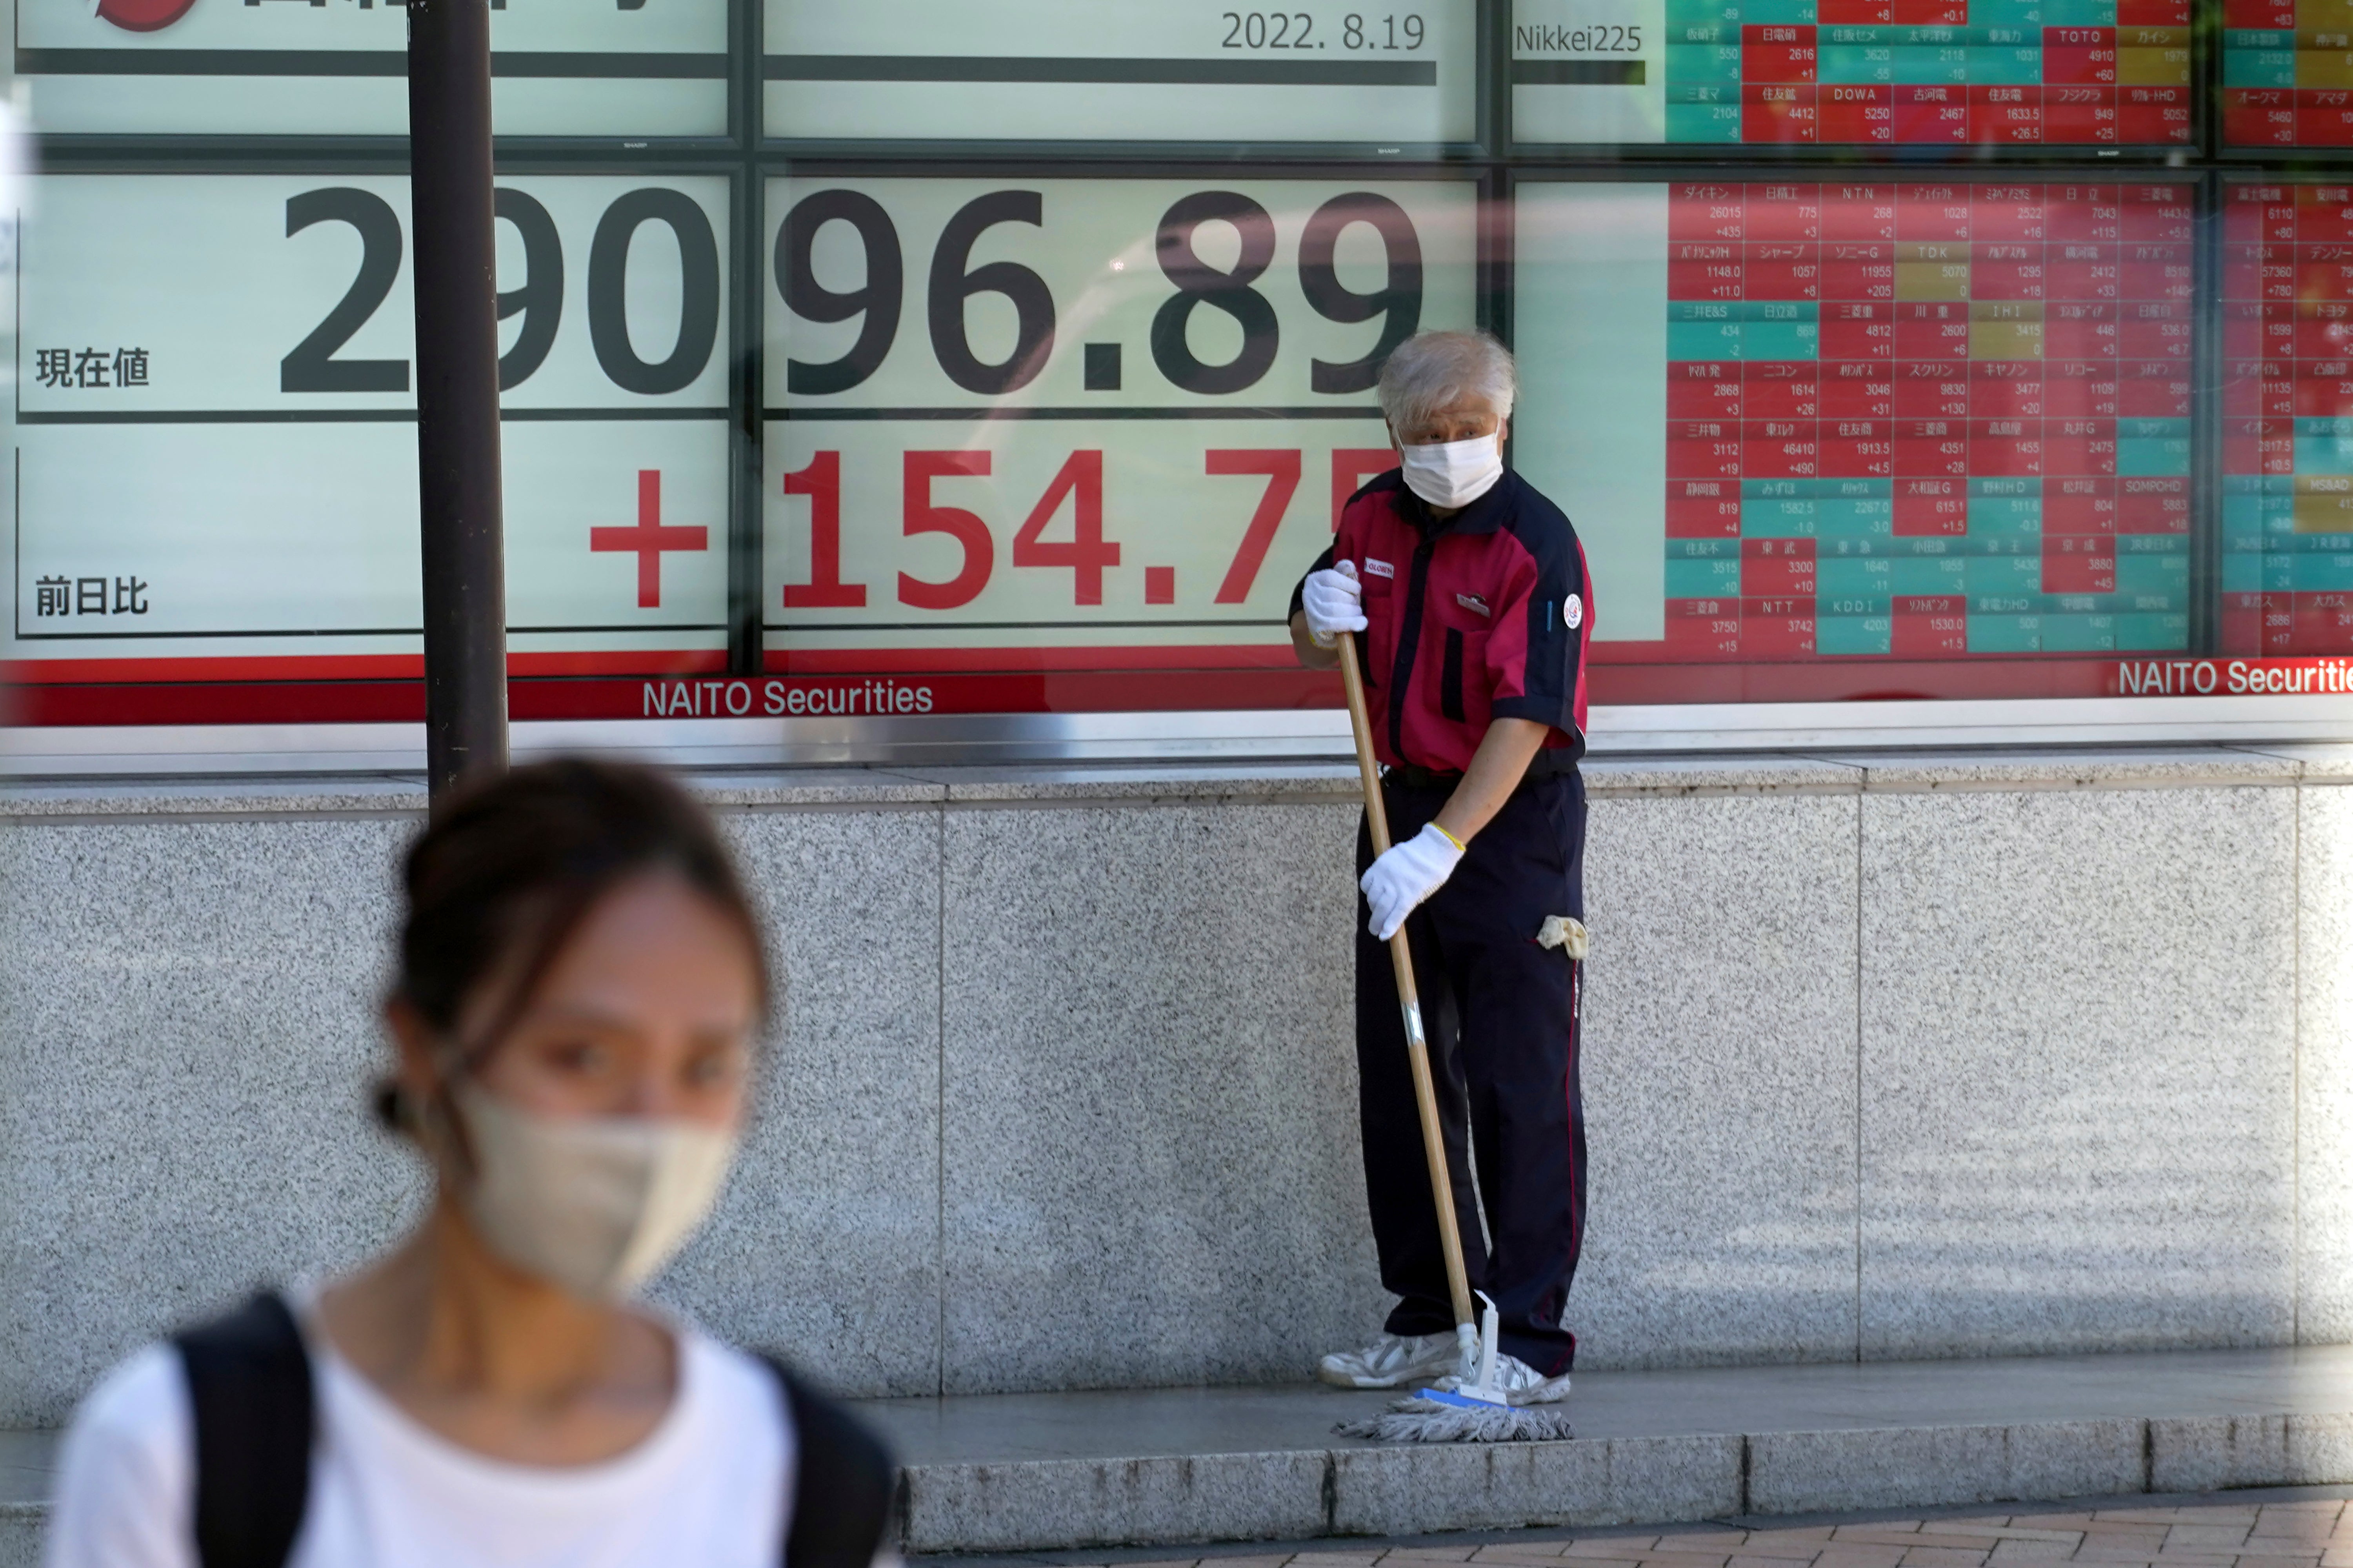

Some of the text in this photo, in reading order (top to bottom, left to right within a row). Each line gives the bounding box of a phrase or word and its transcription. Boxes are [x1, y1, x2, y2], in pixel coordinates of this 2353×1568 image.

[1877, 9, 1889, 20] +8
[1943, 10, 1963, 21] +0.1
[1343, 13, 1425, 50] 8.19
[2059, 30, 2100, 43] TOTO
[1517, 25, 1642, 52] Nikkei225
[1789, 48, 1814, 60] 2616
[2089, 50, 2113, 62] 4910
[1801, 68, 1813, 79] +1
[2095, 69, 2113, 80] +60
[1834, 88, 1876, 100] DOWA
[1713, 107, 1738, 119] 2104
[1789, 108, 1814, 119] 4412
[1865, 108, 1889, 120] 5250
[1940, 108, 1964, 120] 2467
[2007, 108, 2039, 120] 1633.5
[2095, 109, 2113, 120] 949
[1802, 127, 1813, 138] +1
[1871, 127, 1889, 139] +20
[1952, 127, 1964, 138] +6
[2012, 127, 2039, 139] +26.5
[2095, 127, 2113, 139] +25
[1843, 187, 1873, 199] NTN
[1710, 207, 1741, 218] 26015
[1798, 206, 1817, 218] 775
[1873, 207, 1892, 218] 268
[1944, 207, 1967, 218] 1028
[2092, 207, 2116, 219] 7043
[2268, 207, 2293, 220] 6110
[1716, 226, 1740, 237] +435
[1804, 226, 1817, 237] +3
[1880, 226, 1892, 238] +2
[1955, 226, 1967, 238] +6
[2024, 227, 2041, 238] +16
[2091, 227, 2116, 238] +115
[1918, 246, 1947, 258] TDK
[1707, 266, 1740, 277] 1148.0
[1792, 265, 1816, 278] 1057
[1862, 266, 1891, 278] 11955
[2017, 266, 2041, 278] 1295
[2091, 266, 2115, 278] 2412
[1712, 285, 1740, 297] +11.0
[1804, 285, 1816, 296] +8
[1867, 285, 1891, 297] +205
[2022, 285, 2041, 296] +18
[1993, 305, 2020, 317] IHI
[2317, 305, 2347, 318] トヨタ
[1866, 325, 1891, 336] 4812
[1941, 325, 1966, 336] 2600
[1872, 345, 1889, 355] +11
[1953, 344, 1966, 355] +6
[35, 347, 150, 389] 現在値
[1764, 365, 1797, 378] ニコン
[1714, 384, 1739, 396] 2868
[1791, 384, 1815, 395] 1614
[1866, 384, 1890, 395] 3046
[2015, 383, 2040, 395] 3477
[1726, 403, 1739, 415] +3
[1796, 403, 1815, 415] +26
[1871, 403, 1889, 415] +31
[1941, 403, 1965, 414] +130
[2021, 402, 2039, 414] +20
[2095, 403, 2114, 413] +19
[1713, 443, 1738, 456] 3112
[1783, 443, 1814, 455] 46410
[1857, 443, 1889, 454] 1913.5
[1940, 442, 1963, 454] 4351
[2089, 442, 2113, 453] 2475
[1719, 463, 1738, 474] +19
[1789, 463, 1814, 474] +490
[1867, 462, 1889, 473] +4.5
[1946, 461, 1964, 473] +28
[1719, 503, 1738, 514] 819
[1936, 501, 1963, 513] 615.1
[1725, 522, 1737, 533] +4
[1942, 520, 1964, 532] +1.5
[1788, 561, 1813, 573] 3300
[1794, 580, 1813, 592] +10
[35, 575, 149, 617] 前日比
[1763, 601, 1793, 613] NTT
[1833, 601, 1873, 612] KDDI
[1712, 621, 1737, 633] 3750
[1788, 620, 1813, 632] 3742
[1930, 618, 1963, 630] 1530.0
[1800, 640, 1812, 650] +4
[1942, 638, 1963, 649] +1.5
[2272, 634, 2290, 644] +17
[1718, 640, 1737, 652] +15
[2118, 661, 2217, 694] NAITO
[642, 680, 933, 718] NAITO Securities
